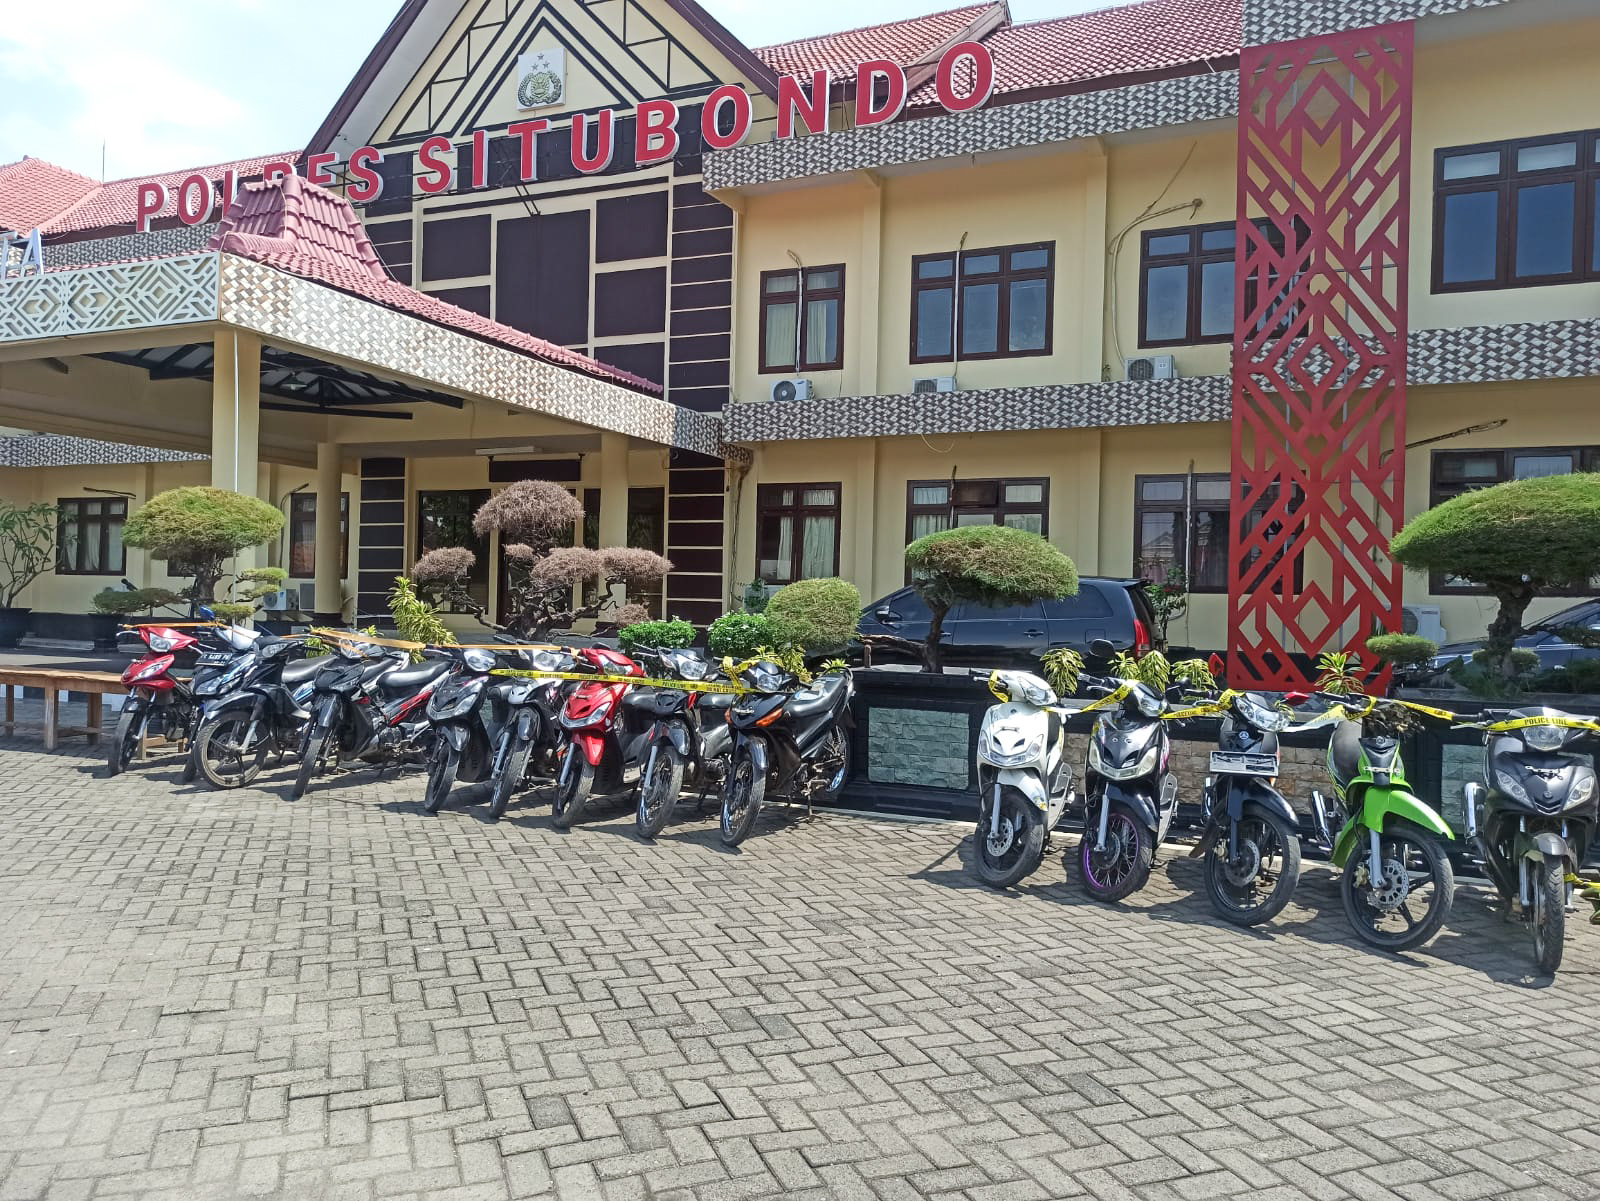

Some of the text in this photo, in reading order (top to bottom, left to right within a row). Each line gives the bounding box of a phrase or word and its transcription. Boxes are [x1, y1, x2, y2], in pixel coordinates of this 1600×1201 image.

[417, 41, 995, 194] SITUBONDO
[1524, 717, 1569, 726] POLICE LINE
